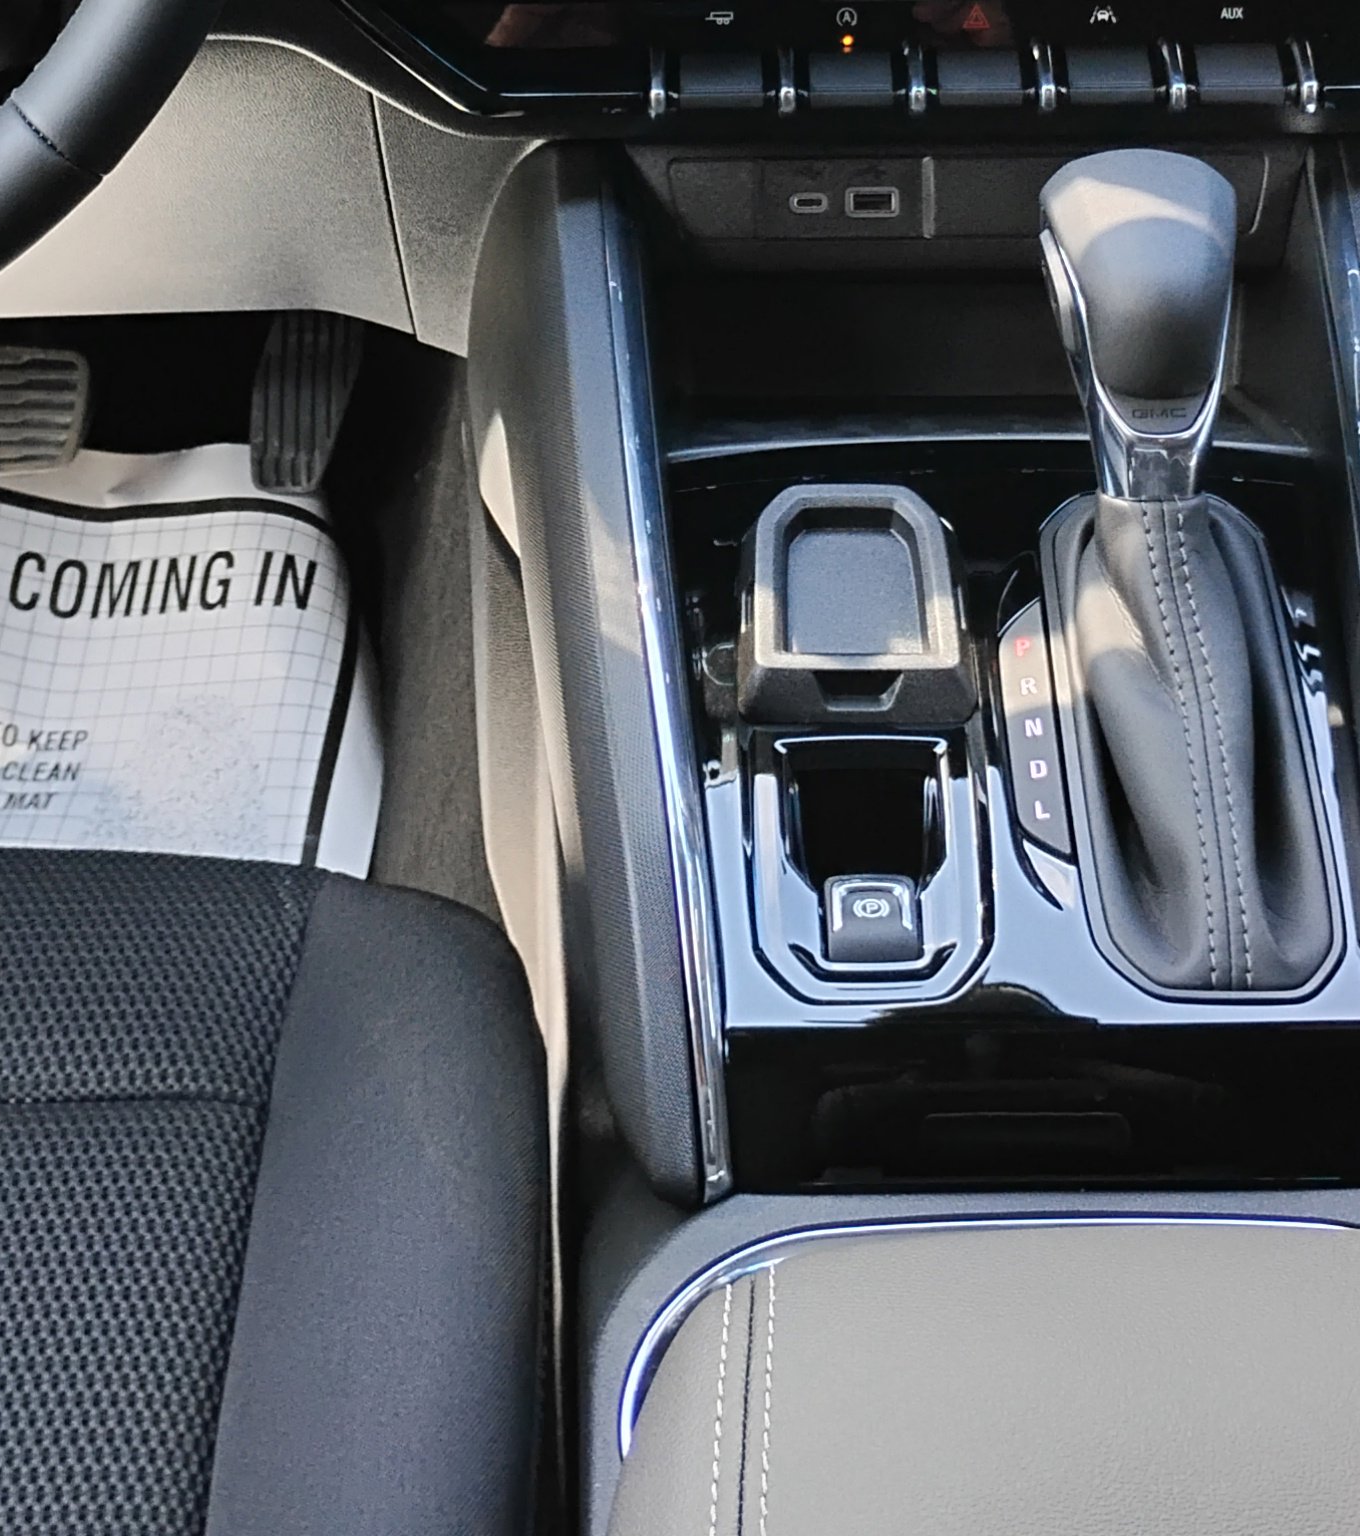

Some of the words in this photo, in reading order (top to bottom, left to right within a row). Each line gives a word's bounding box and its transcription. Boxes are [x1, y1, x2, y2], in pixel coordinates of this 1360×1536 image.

[1220, 6, 1244, 20] AUX
[1132, 407, 1187, 419] GMC
[9, 550, 235, 620] COMING
[254, 551, 319, 611] IN
[1014, 636, 1031, 657] P
[1020, 677, 1038, 696] R
[1024, 717, 1043, 738] N
[27, 730, 89, 752] KEEP
[2, 761, 82, 782] CLEAN
[1029, 759, 1048, 779] D
[2, 790, 58, 811] MAT
[1034, 800, 1050, 820] L
